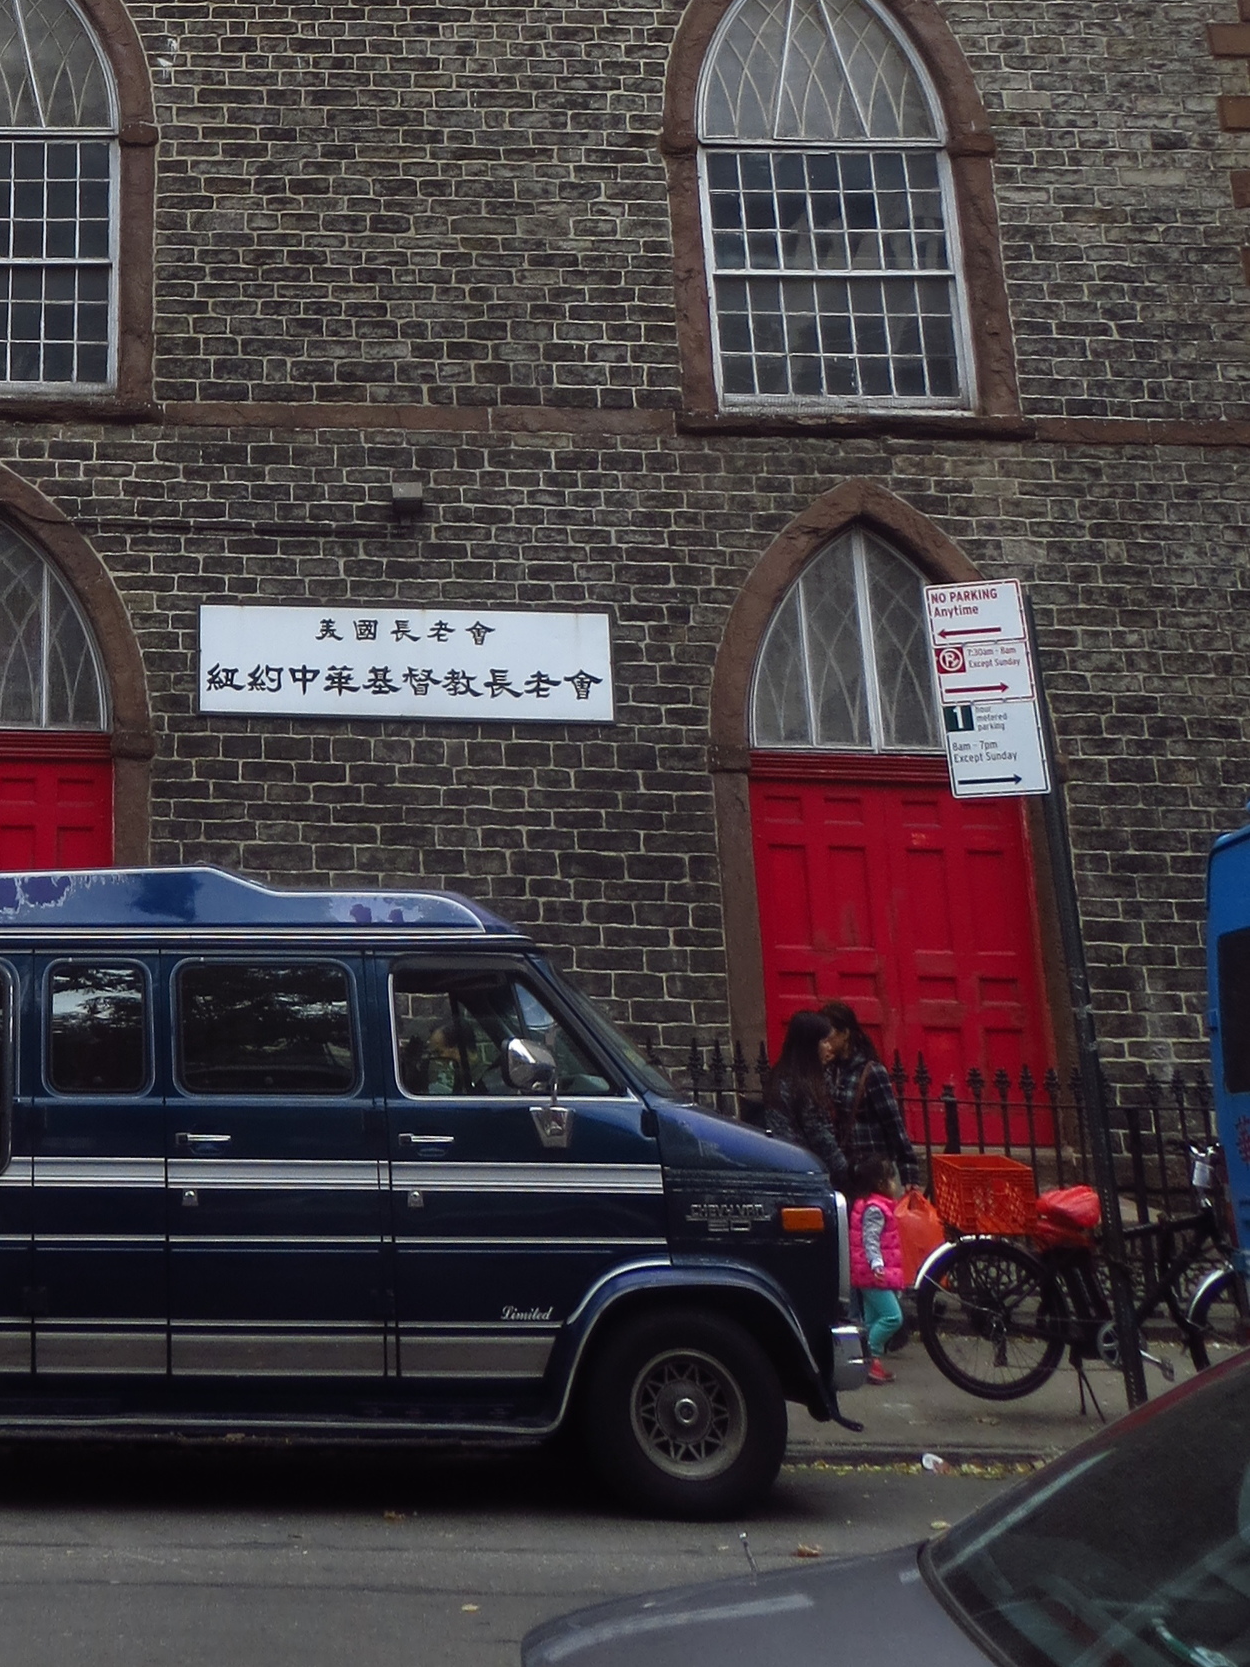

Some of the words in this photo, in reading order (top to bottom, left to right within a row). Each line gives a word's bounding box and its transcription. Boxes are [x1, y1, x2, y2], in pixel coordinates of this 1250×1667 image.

[930, 592, 946, 605] NO
[949, 588, 998, 603] PARKING
[933, 605, 979, 619] Anytime
[314, 618, 496, 646] 美國長老會
[966, 648, 994, 657] 7:30am
[1000, 646, 1017, 654] 8am
[968, 659, 994, 669] Except
[994, 657, 1021, 667] Sunday
[206, 662, 604, 701] 紐約中華基督教長老會
[952, 706, 964, 729] 1
[976, 712, 1008, 722] metered
[977, 722, 1006, 732] parking
[952, 742, 971, 752] 8am
[979, 740, 998, 751] 7pm
[953, 752, 983, 764] Except
[985, 751, 1018, 762] Sunday
[500, 1305, 554, 1321] Limited
